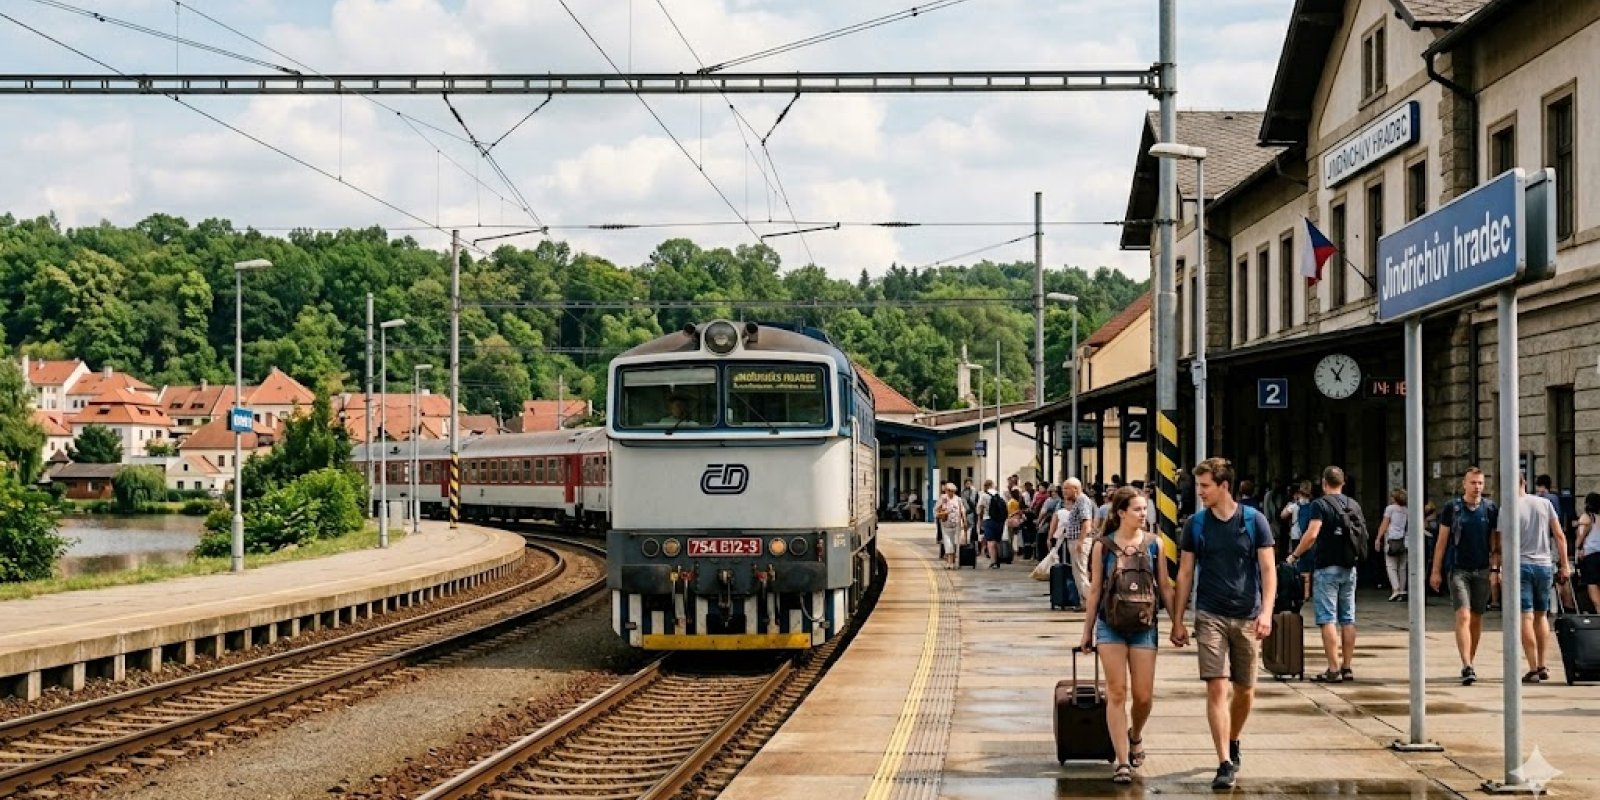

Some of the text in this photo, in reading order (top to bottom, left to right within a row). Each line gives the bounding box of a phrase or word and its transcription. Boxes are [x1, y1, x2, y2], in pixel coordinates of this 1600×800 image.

[1454, 210, 1512, 273] hradec
[1265, 384, 1281, 405] 2
[1128, 420, 1142, 439] 2
[691, 540, 718, 554] 754
